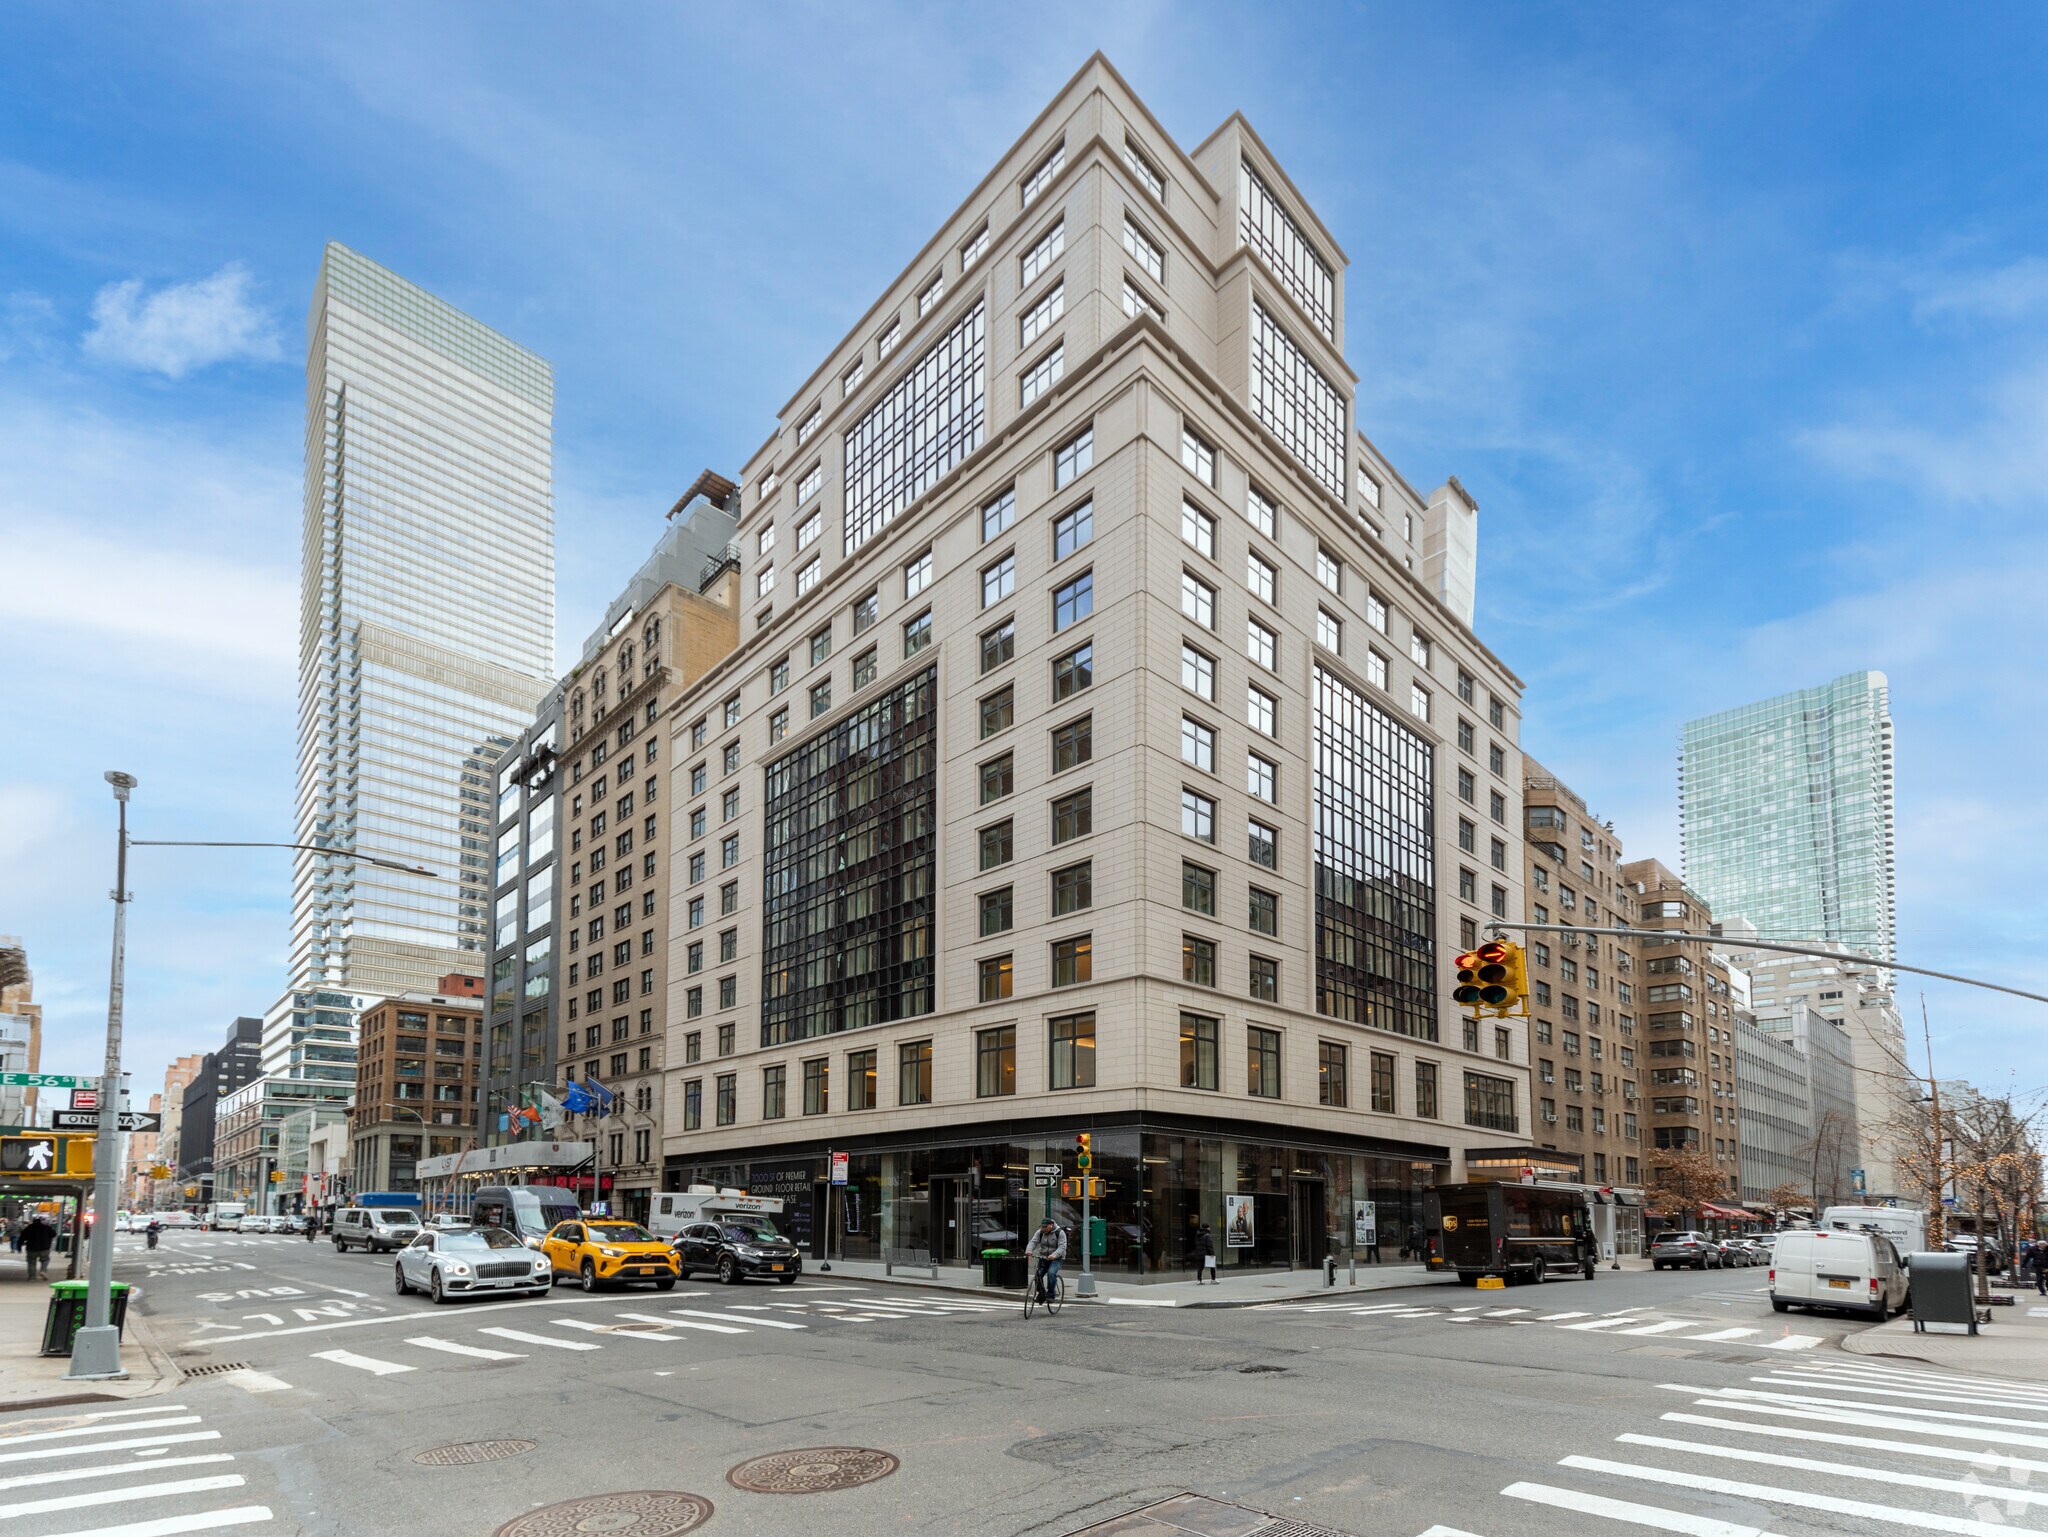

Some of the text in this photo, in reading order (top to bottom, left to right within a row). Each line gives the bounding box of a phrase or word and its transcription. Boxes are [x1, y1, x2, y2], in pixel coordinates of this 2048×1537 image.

[2, 1074, 17, 1085] E
[28, 1074, 58, 1087] 56
[68, 1115, 98, 1124] ONE
[776, 1171, 784, 1181] OF
[751, 1182, 811, 1194] GROUND FLOOR RETAIL
[735, 1202, 761, 1210] verizon
[674, 1208, 695, 1219] verizon
[1443, 1220, 1457, 1229] ups
[196, 1286, 305, 1301] BUS
